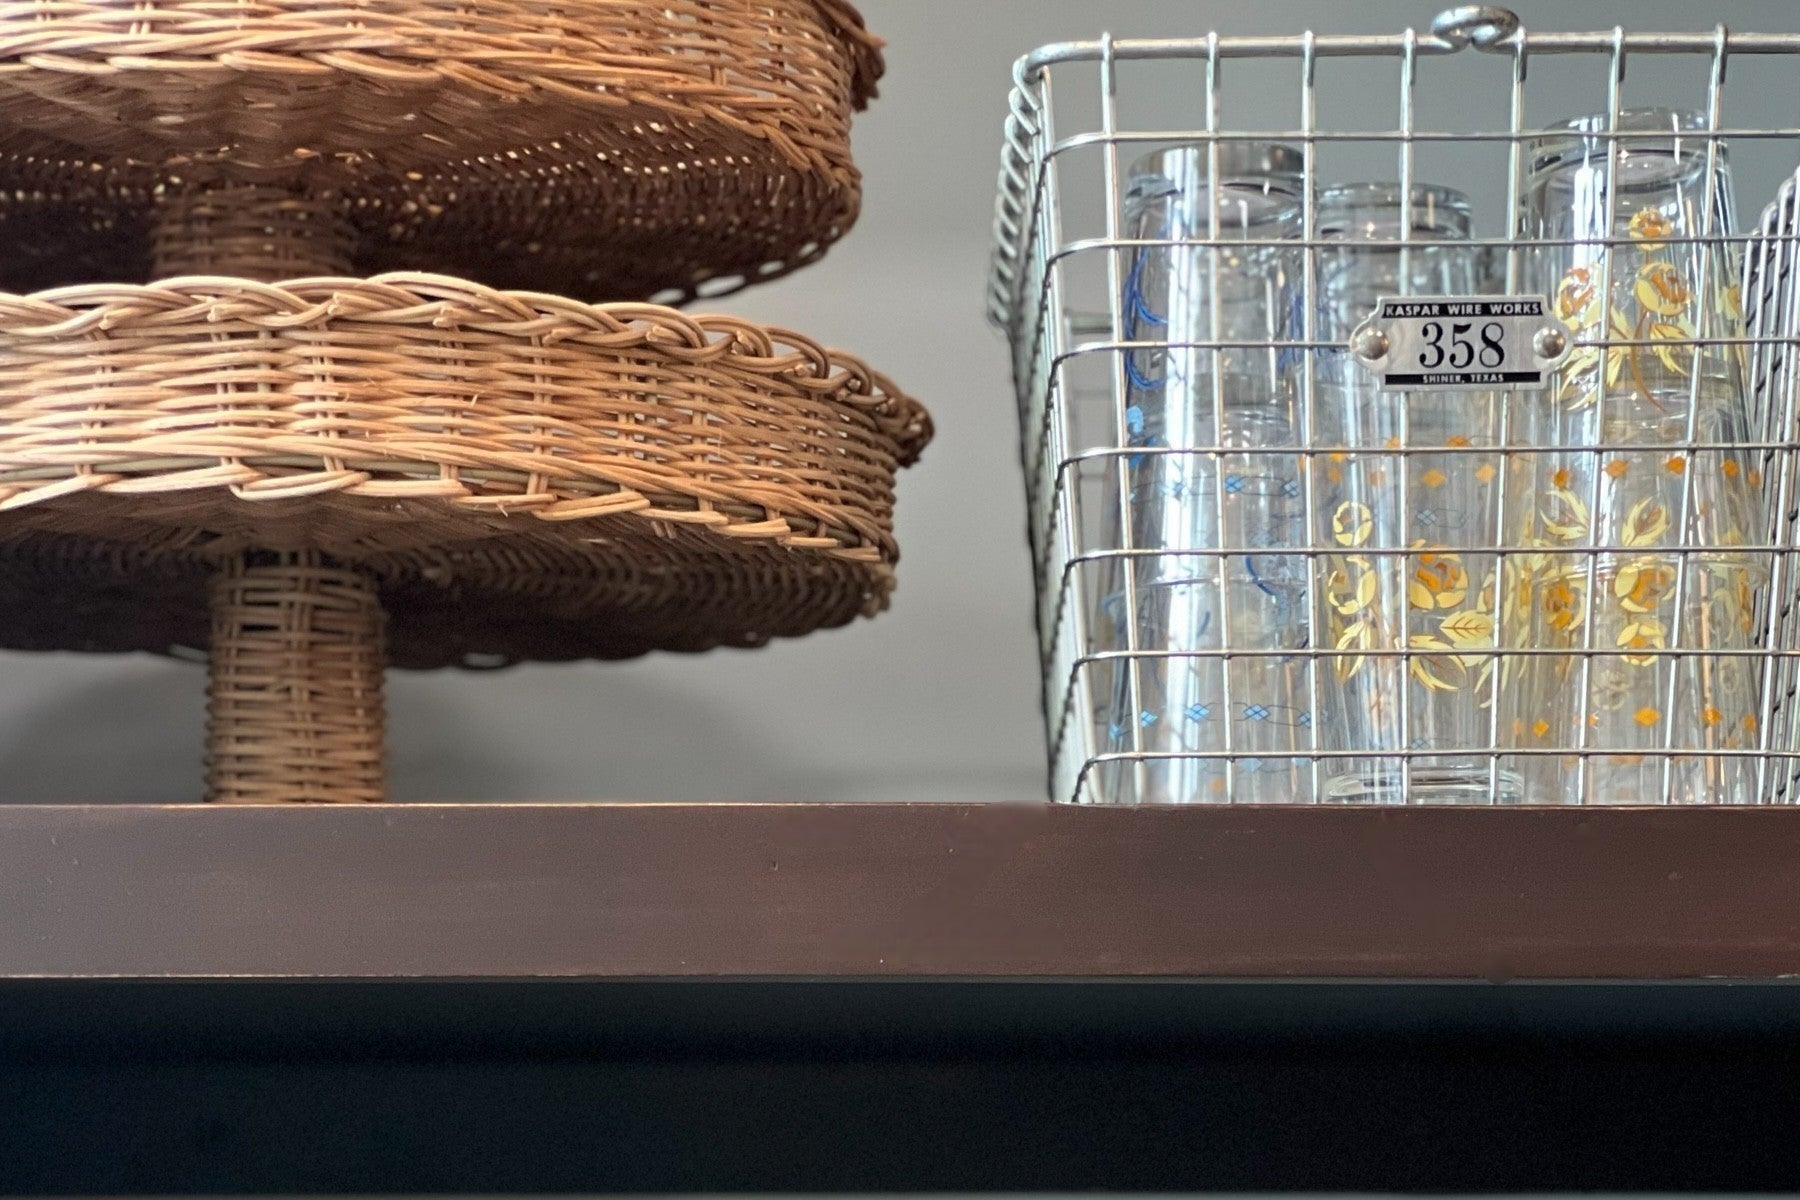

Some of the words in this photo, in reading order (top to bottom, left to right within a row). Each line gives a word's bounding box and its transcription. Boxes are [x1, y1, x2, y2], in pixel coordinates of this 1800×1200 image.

[1385, 304, 1440, 317] KASPAR
[1447, 303, 1482, 316] WIRE
[1490, 302, 1540, 315] WORKS
[1419, 322, 1505, 368] 358
[1471, 373, 1504, 383] TEXAS
